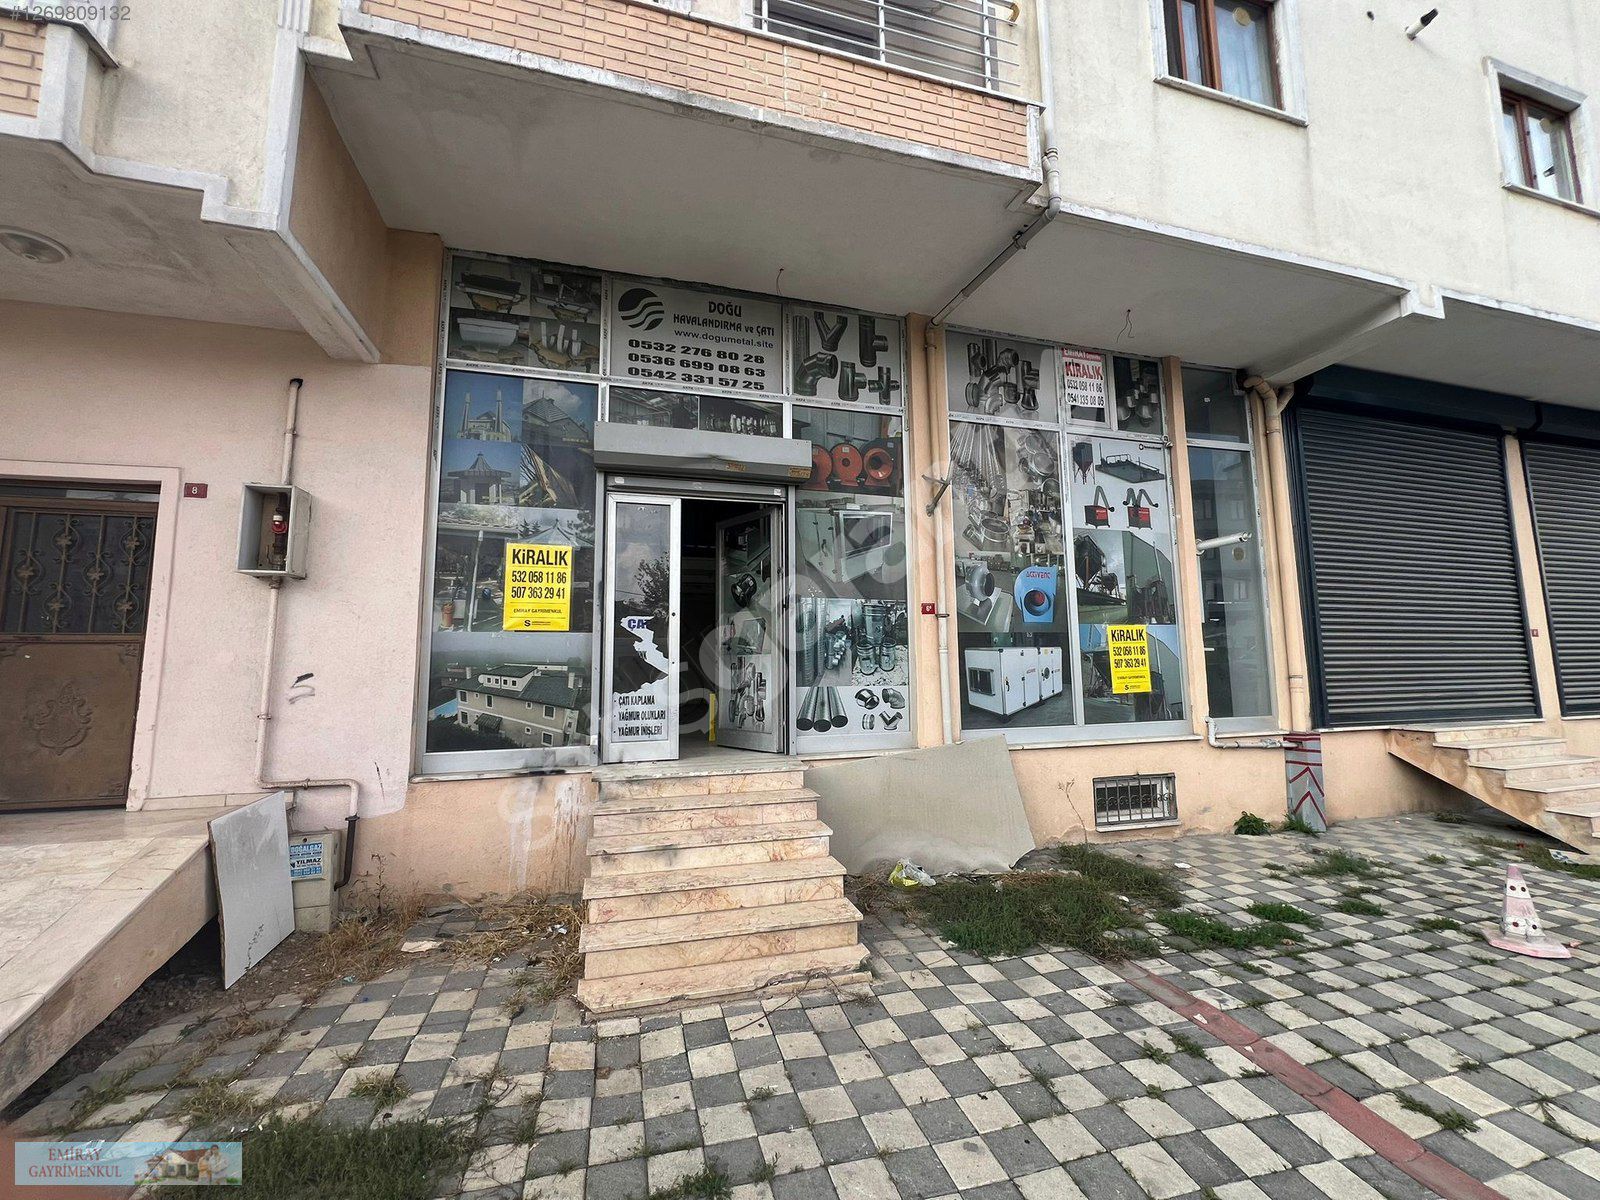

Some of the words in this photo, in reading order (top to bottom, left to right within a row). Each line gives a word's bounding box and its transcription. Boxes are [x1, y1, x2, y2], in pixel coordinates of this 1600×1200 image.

[708, 300, 742, 317] DOĞU
[673, 314, 742, 332] HAVALANDIRMA
[756, 326, 774, 337] ÇATI
[674, 330, 774, 349] www.dogumetal.site
[628, 339, 676, 353] 0532
[680, 346, 712, 357] 276
[716, 350, 739, 360] 80
[743, 354, 765, 364] 28
[628, 353, 675, 366] 0536
[680, 359, 714, 370] 699
[718, 364, 740, 374] 08
[744, 367, 765, 377] 63
[1065, 360, 1103, 380] KİRALIK
[628, 367, 676, 380] 0542
[681, 373, 714, 385] 331
[718, 378, 738, 388] 57
[742, 380, 764, 390] 25
[1089, 382, 1095, 392] 11
[512, 549, 568, 566] KiRALIK
[512, 570, 526, 582] 532
[528, 571, 543, 583] 058
[546, 571, 554, 583] 11
[557, 572, 566, 584] 86
[511, 586, 526, 598] 507
[528, 587, 542, 598] 363
[544, 588, 554, 599] 29
[556, 588, 565, 599] 41
[1113, 647, 1122, 656] 532
[1123, 646, 1132, 656] 058
[1133, 646, 1139, 655] 11
[1140, 646, 1146, 655] 86
[1114, 659, 1123, 668] 507
[1124, 659, 1133, 668] 363
[1134, 658, 1140, 668] 29
[1141, 658, 1146, 667] 41
[618, 696, 630, 708] ÇATI
[631, 695, 655, 705] KAPLAMA
[618, 708, 640, 721] YAĞMUR
[641, 710, 666, 720] OLUKLARI
[618, 724, 640, 736] YAĞMUR
